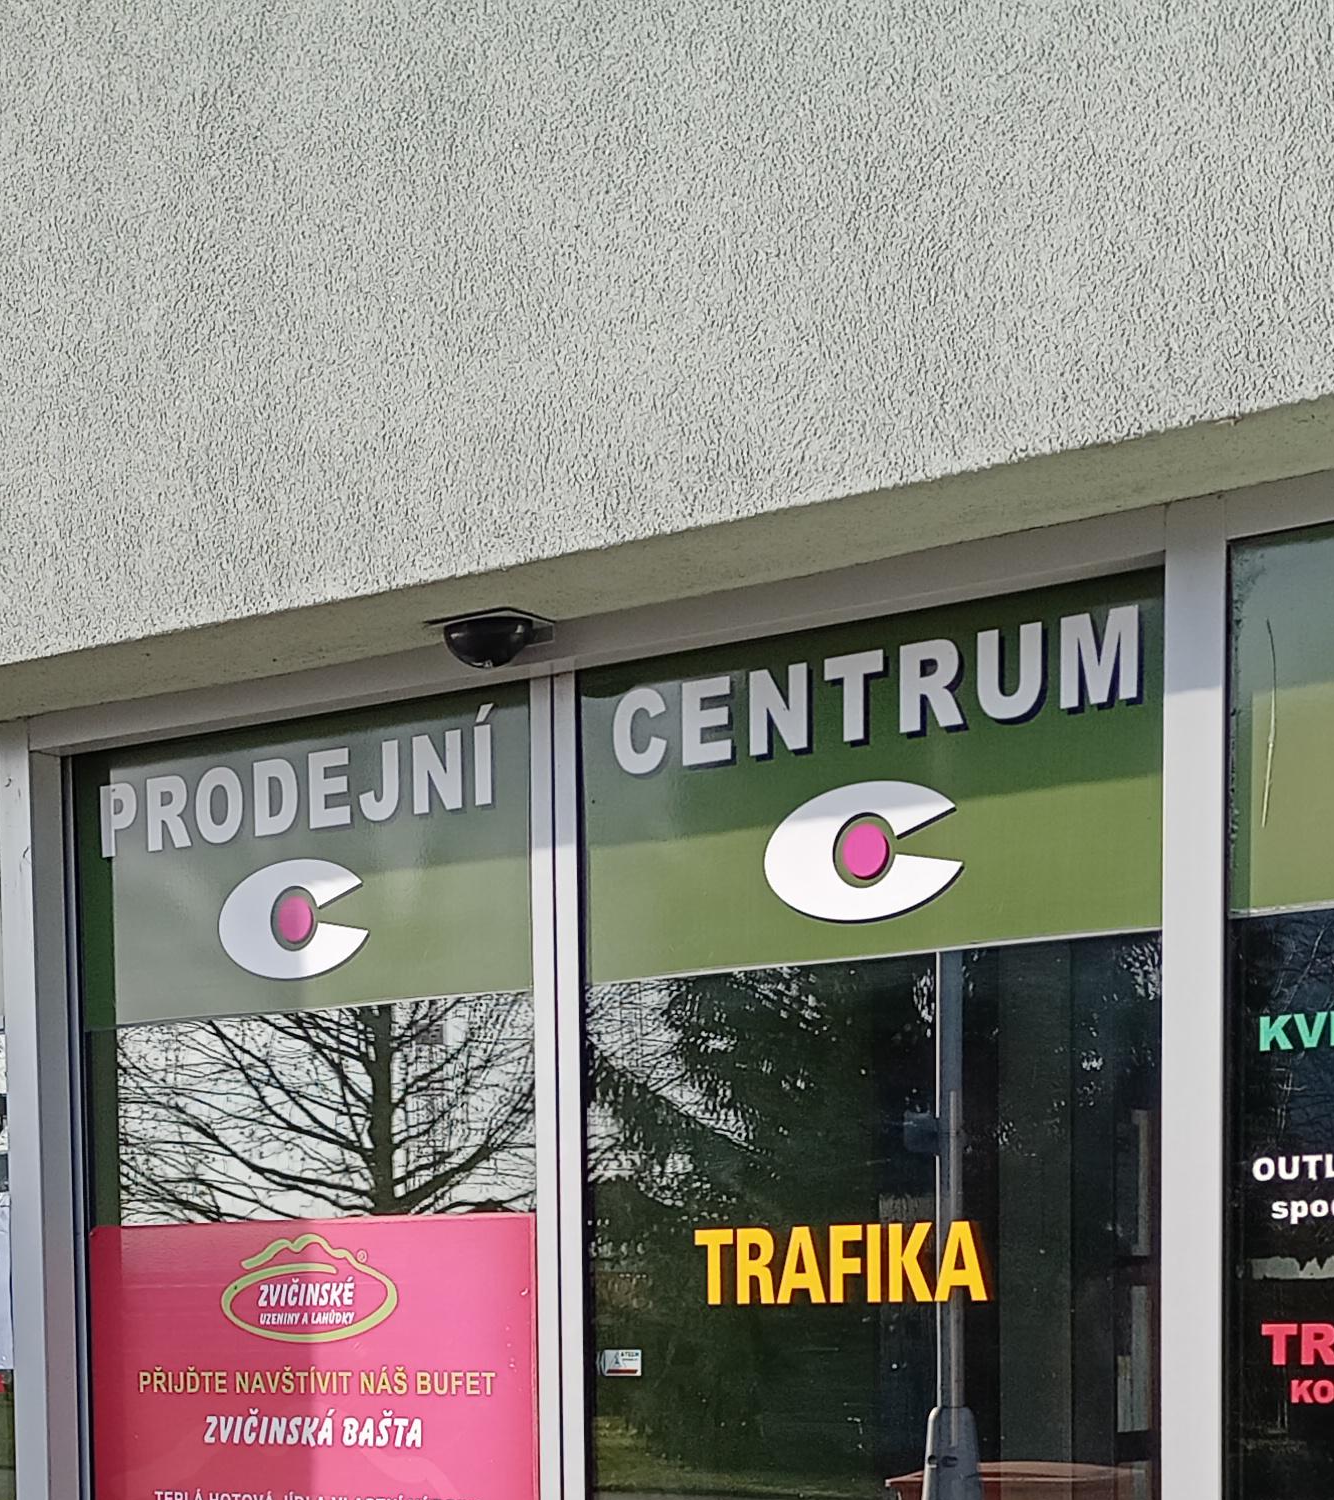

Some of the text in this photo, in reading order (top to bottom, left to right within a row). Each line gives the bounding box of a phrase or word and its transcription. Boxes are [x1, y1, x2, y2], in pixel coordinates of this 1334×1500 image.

[100, 604, 1143, 858] PRODEJNÍ CENTRUM
[694, 1221, 988, 1305] TRAFIKA
[258, 1277, 355, 1307] ZVIČINSKÉ
[260, 1309, 355, 1325] UZENINY A LAHŮDKY
[138, 1366, 496, 1396] PŘIJĎTE NAVŠTÍVIT NÁŠ BUFET
[203, 1408, 423, 1448] ZVIČINSKÁ BAŠTA
